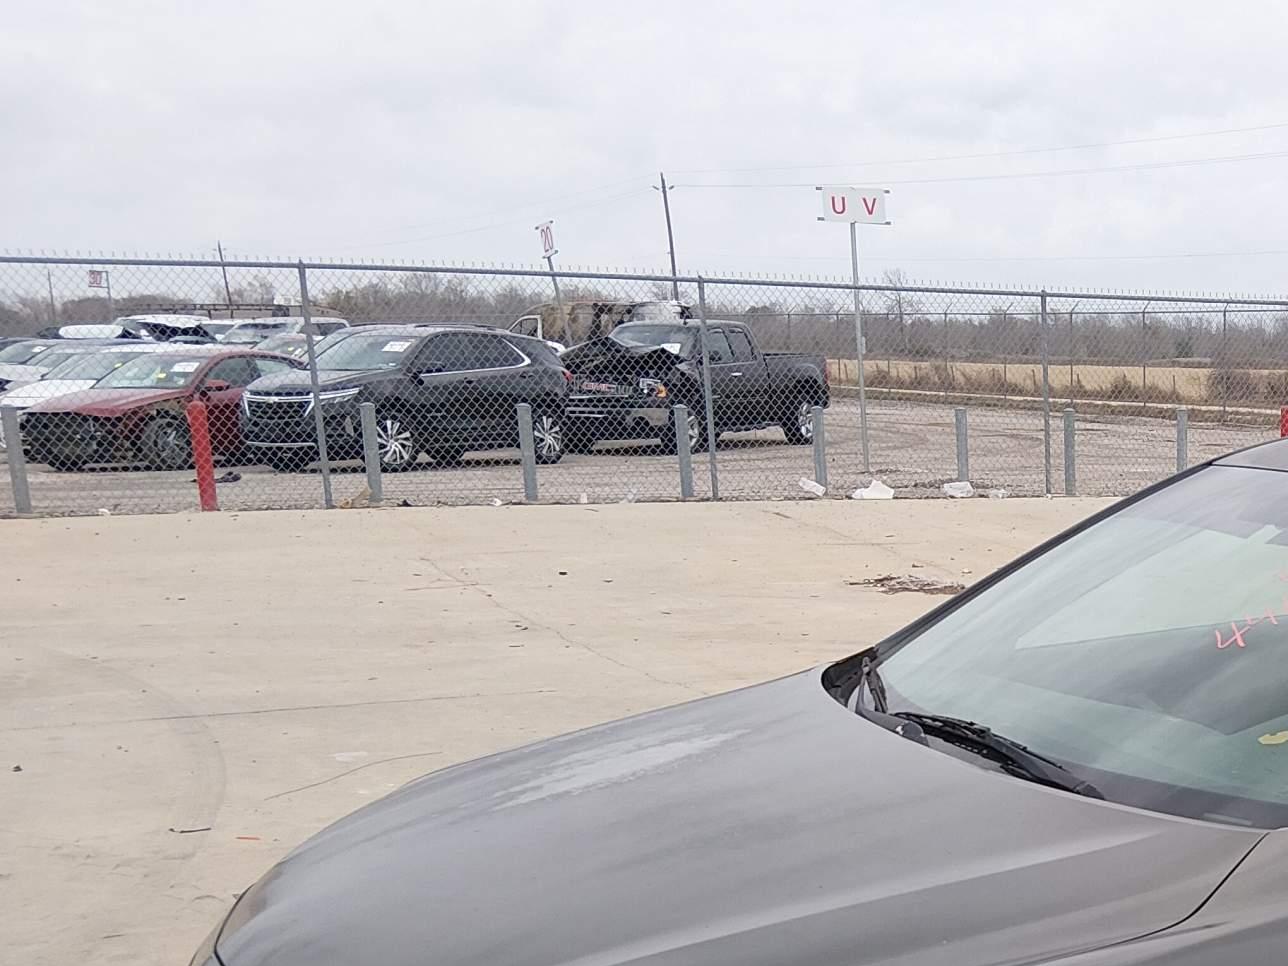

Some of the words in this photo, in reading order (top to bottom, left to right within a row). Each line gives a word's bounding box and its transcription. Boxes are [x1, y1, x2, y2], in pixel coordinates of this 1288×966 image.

[830, 195, 847, 216] U
[861, 196, 877, 216] V
[540, 225, 554, 254] 20
